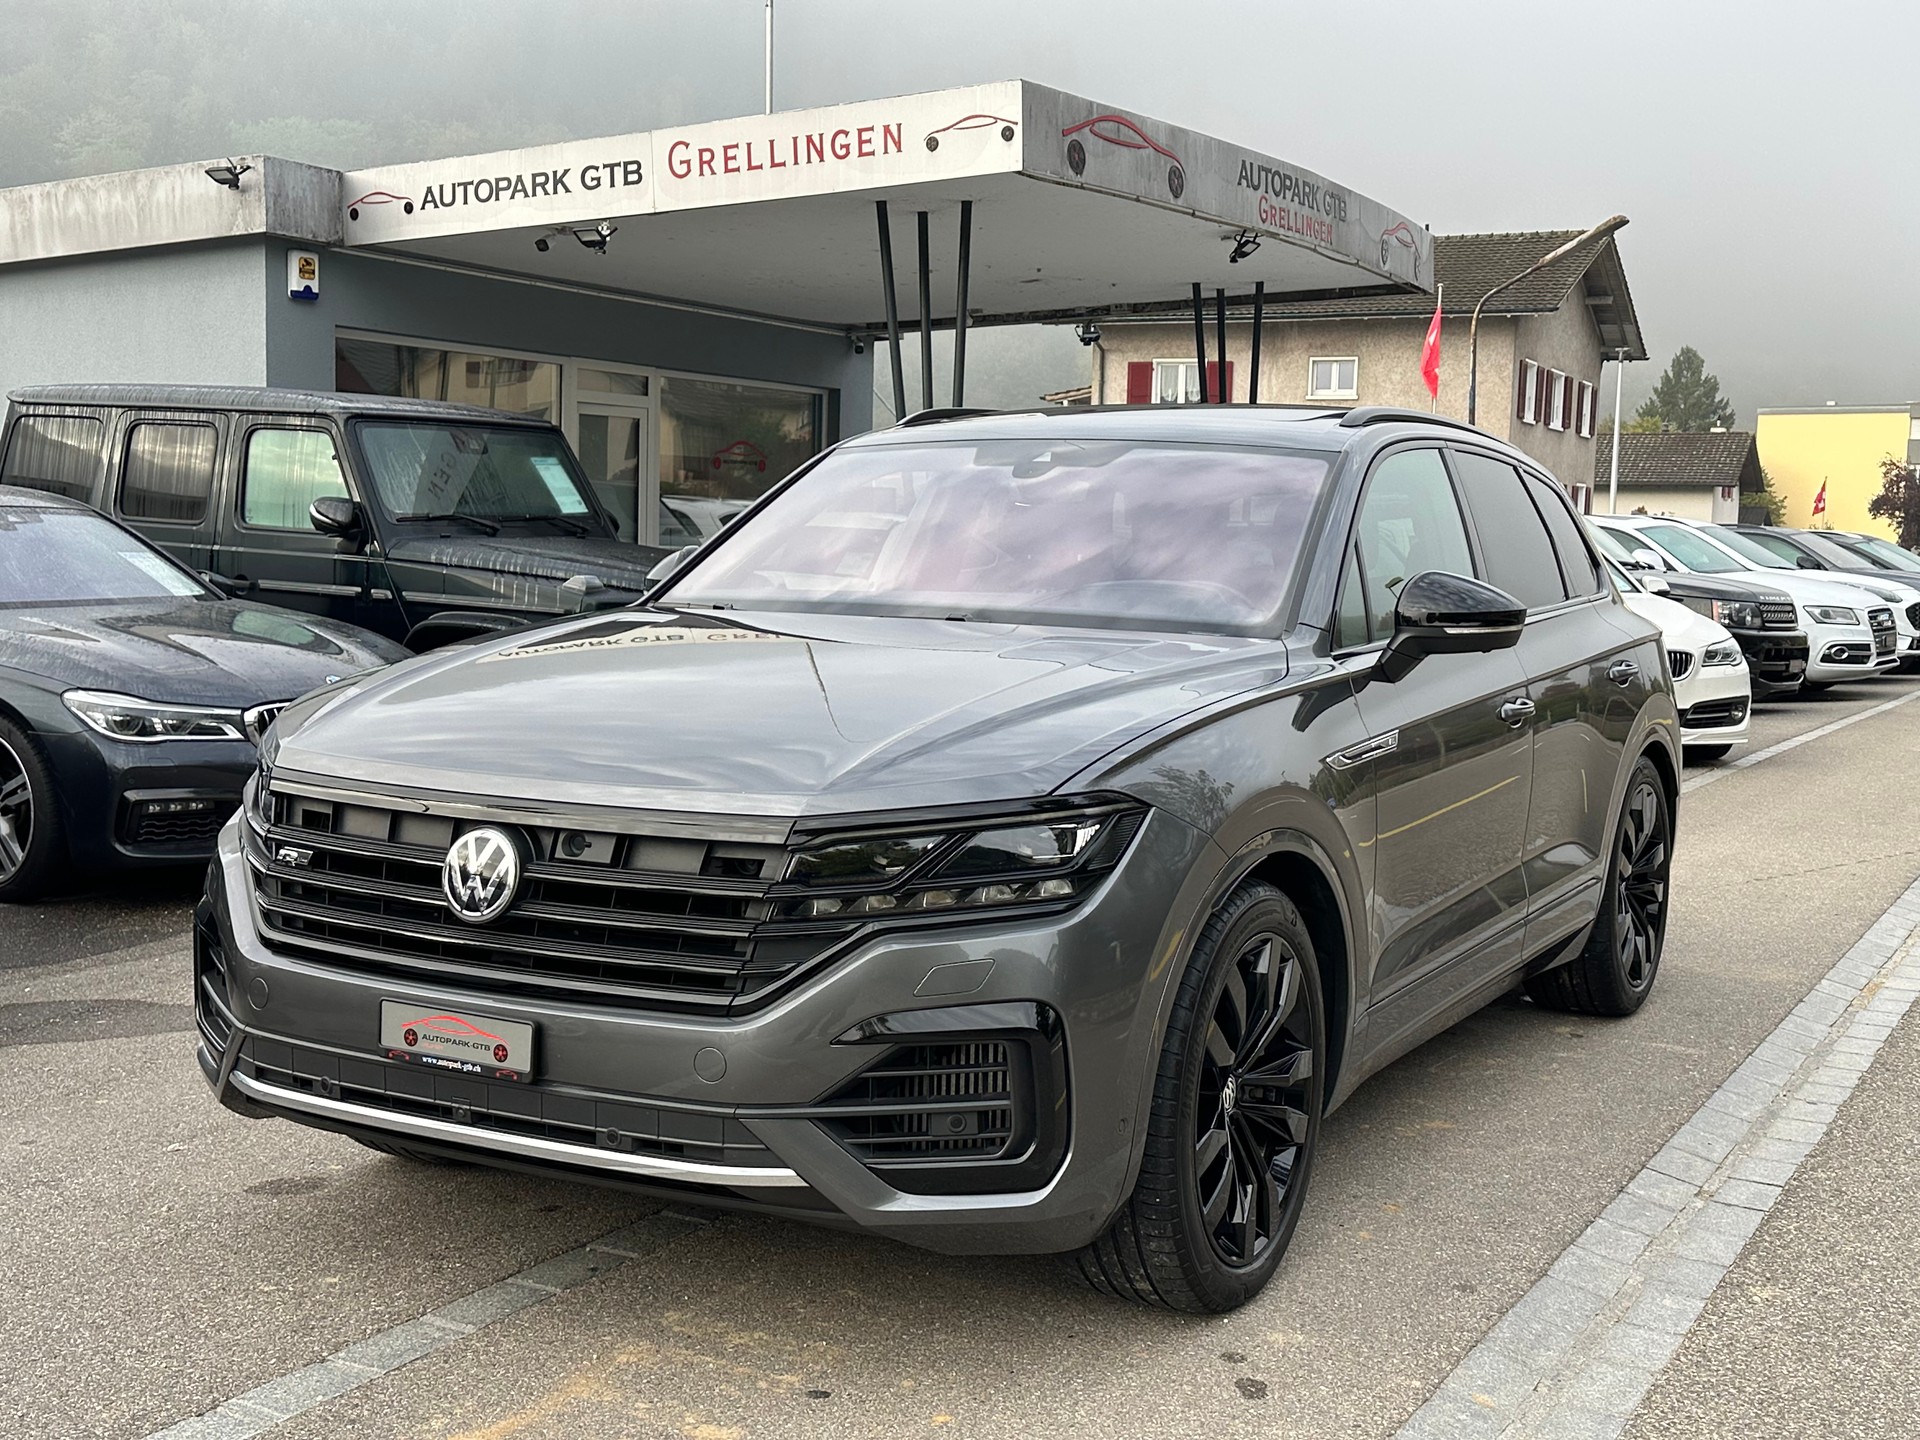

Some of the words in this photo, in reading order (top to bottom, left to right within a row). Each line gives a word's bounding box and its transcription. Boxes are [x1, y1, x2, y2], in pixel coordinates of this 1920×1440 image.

[420, 168, 572, 211] AUTOPARK
[580, 159, 643, 191] GTB
[667, 122, 904, 179] GRELLINGEN
[1237, 159, 1321, 212] AUTOPARK
[1323, 189, 1347, 223] GTB
[1258, 194, 1333, 246] GRELLINGEN
[421, 1033, 491, 1051] AUTOPARK-GTB
